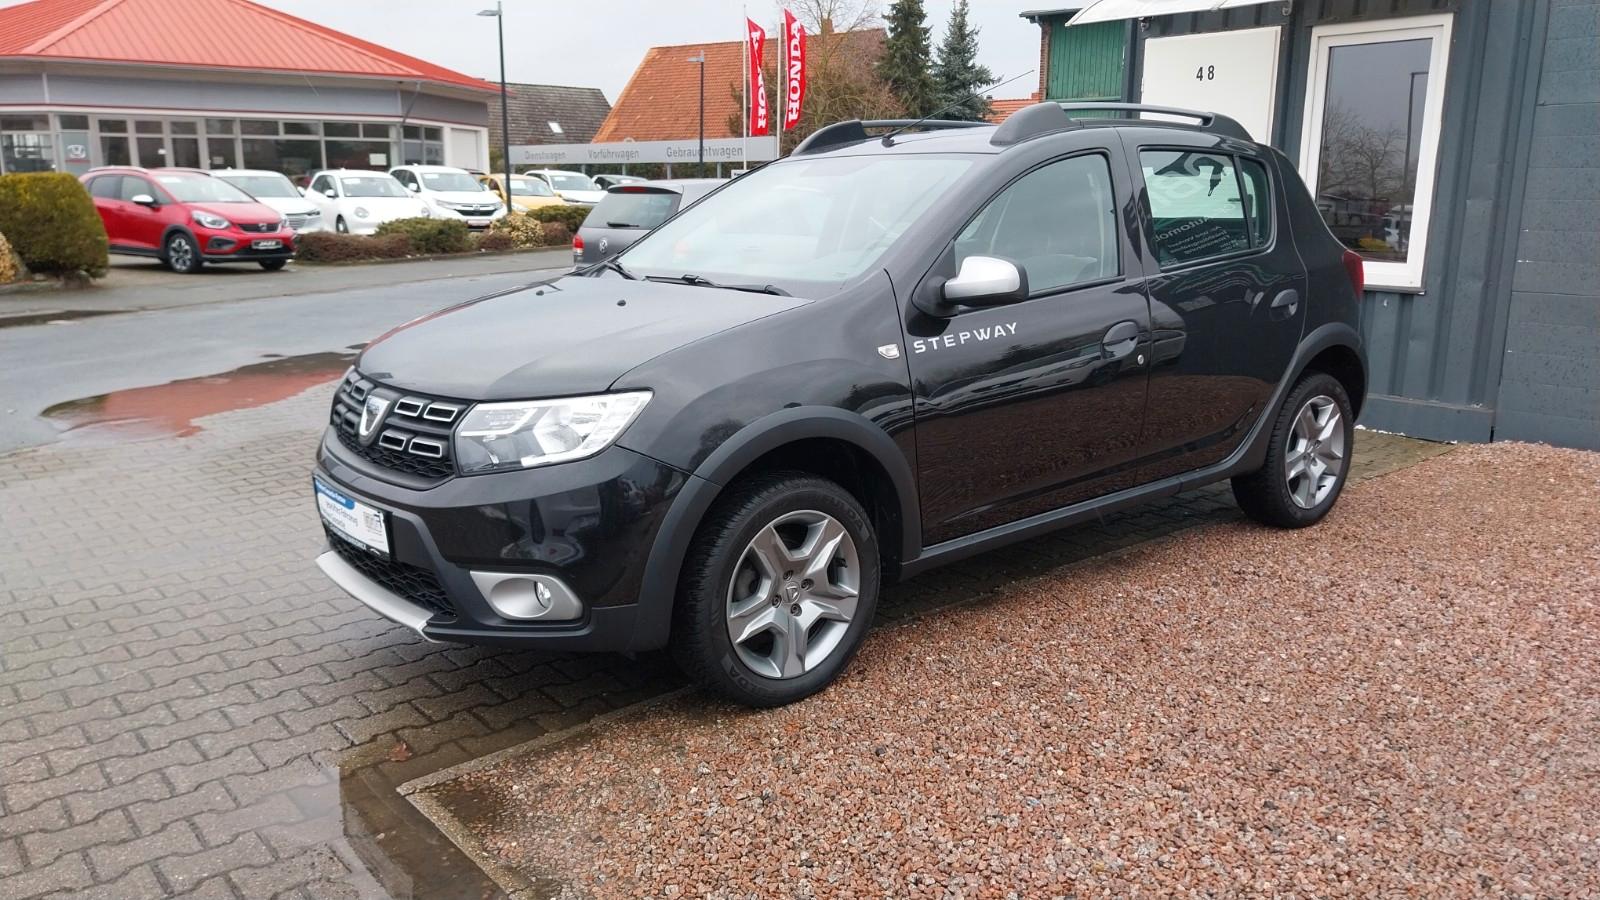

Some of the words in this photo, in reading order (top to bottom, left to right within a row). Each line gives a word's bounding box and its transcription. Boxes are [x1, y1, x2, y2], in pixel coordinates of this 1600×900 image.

[751, 31, 767, 129] HOA
[788, 19, 802, 122] HONDA
[1196, 64, 1215, 81] 48
[666, 146, 744, 159] Gebrauhtwagen
[913, 322, 1017, 353] STEPWAY
